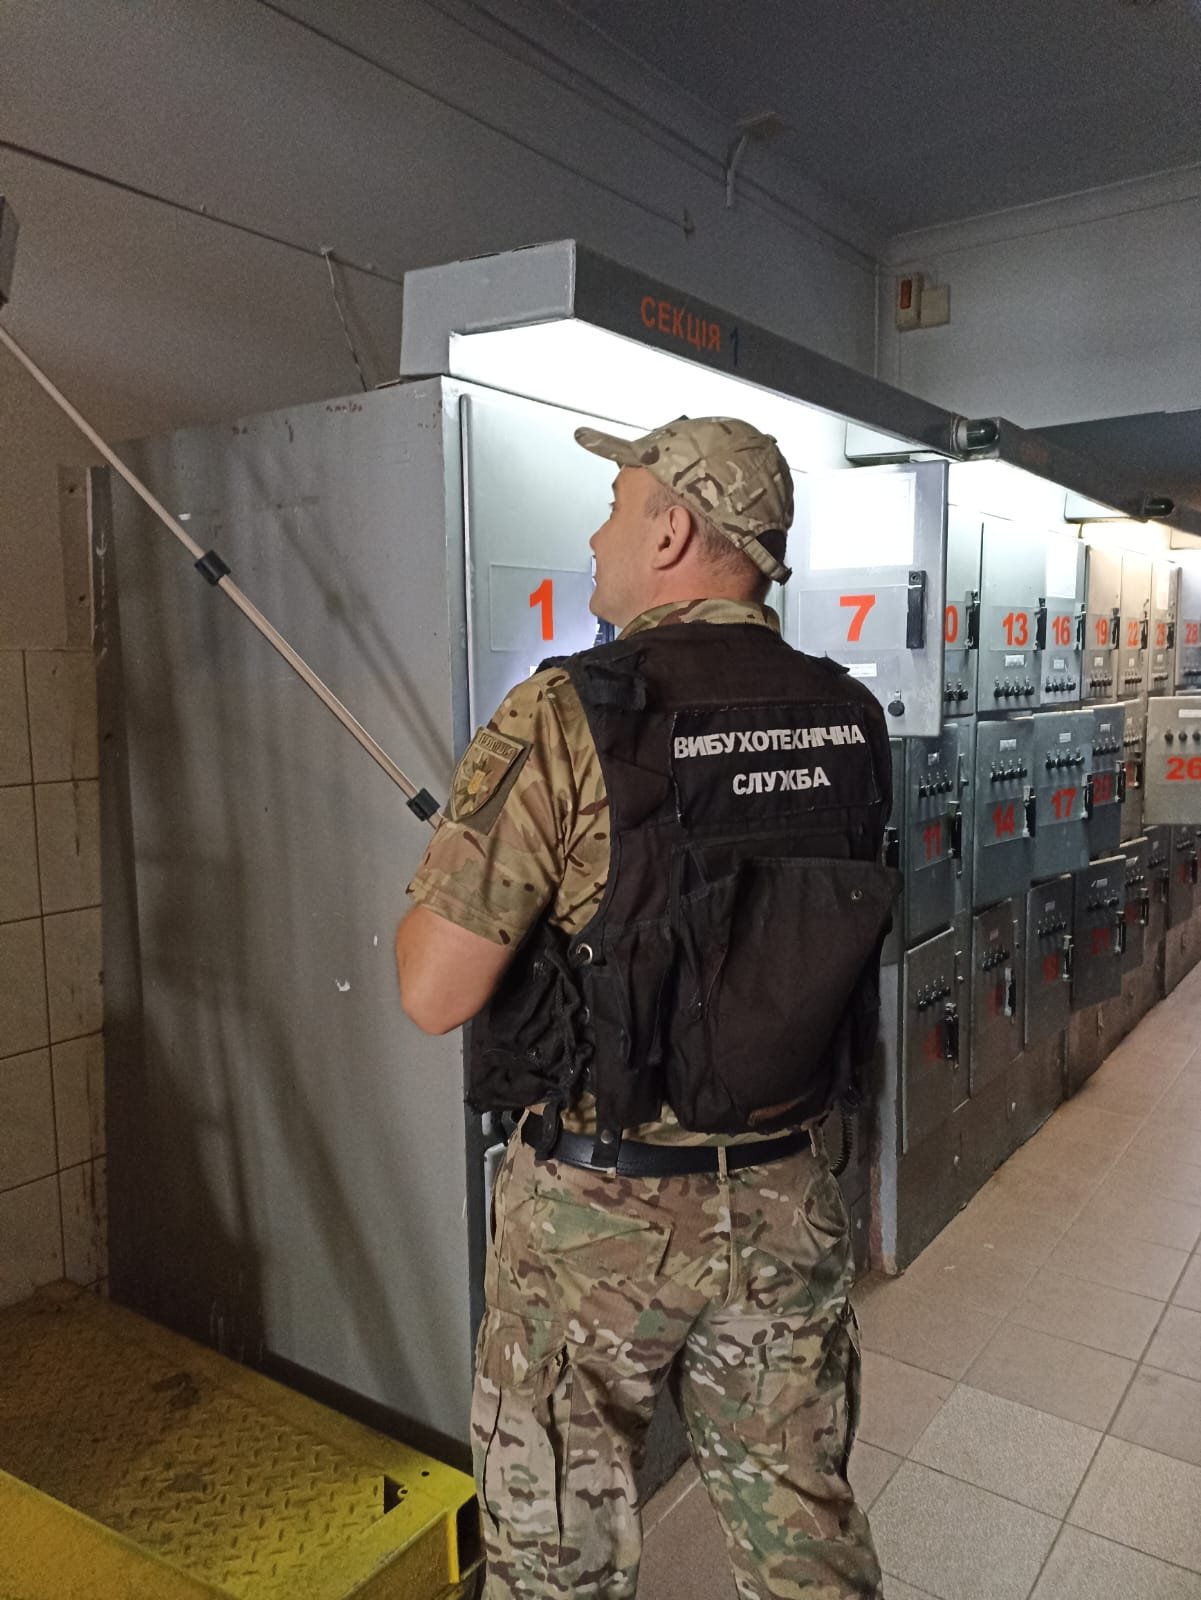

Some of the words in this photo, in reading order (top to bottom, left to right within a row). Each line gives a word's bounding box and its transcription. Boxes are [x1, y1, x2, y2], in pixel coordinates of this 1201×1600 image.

[640, 296, 721, 353] СЕКЦІЯ
[528, 578, 554, 641] 1
[838, 594, 877, 643] 7
[943, 604, 959, 645] 0
[1002, 611, 1029, 647] 13
[1051, 616, 1072, 646] 16
[1093, 617, 1110, 646] 19
[1126, 619, 1141, 649] 22
[674, 724, 866, 760] ВИБУХОТЕХНІЧНА
[732, 766, 831, 796] СЛУЖБА
[1164, 754, 1201, 782] 26
[1051, 787, 1079, 820] 17
[991, 804, 1016, 839] 14
[922, 825, 942, 860] 11
